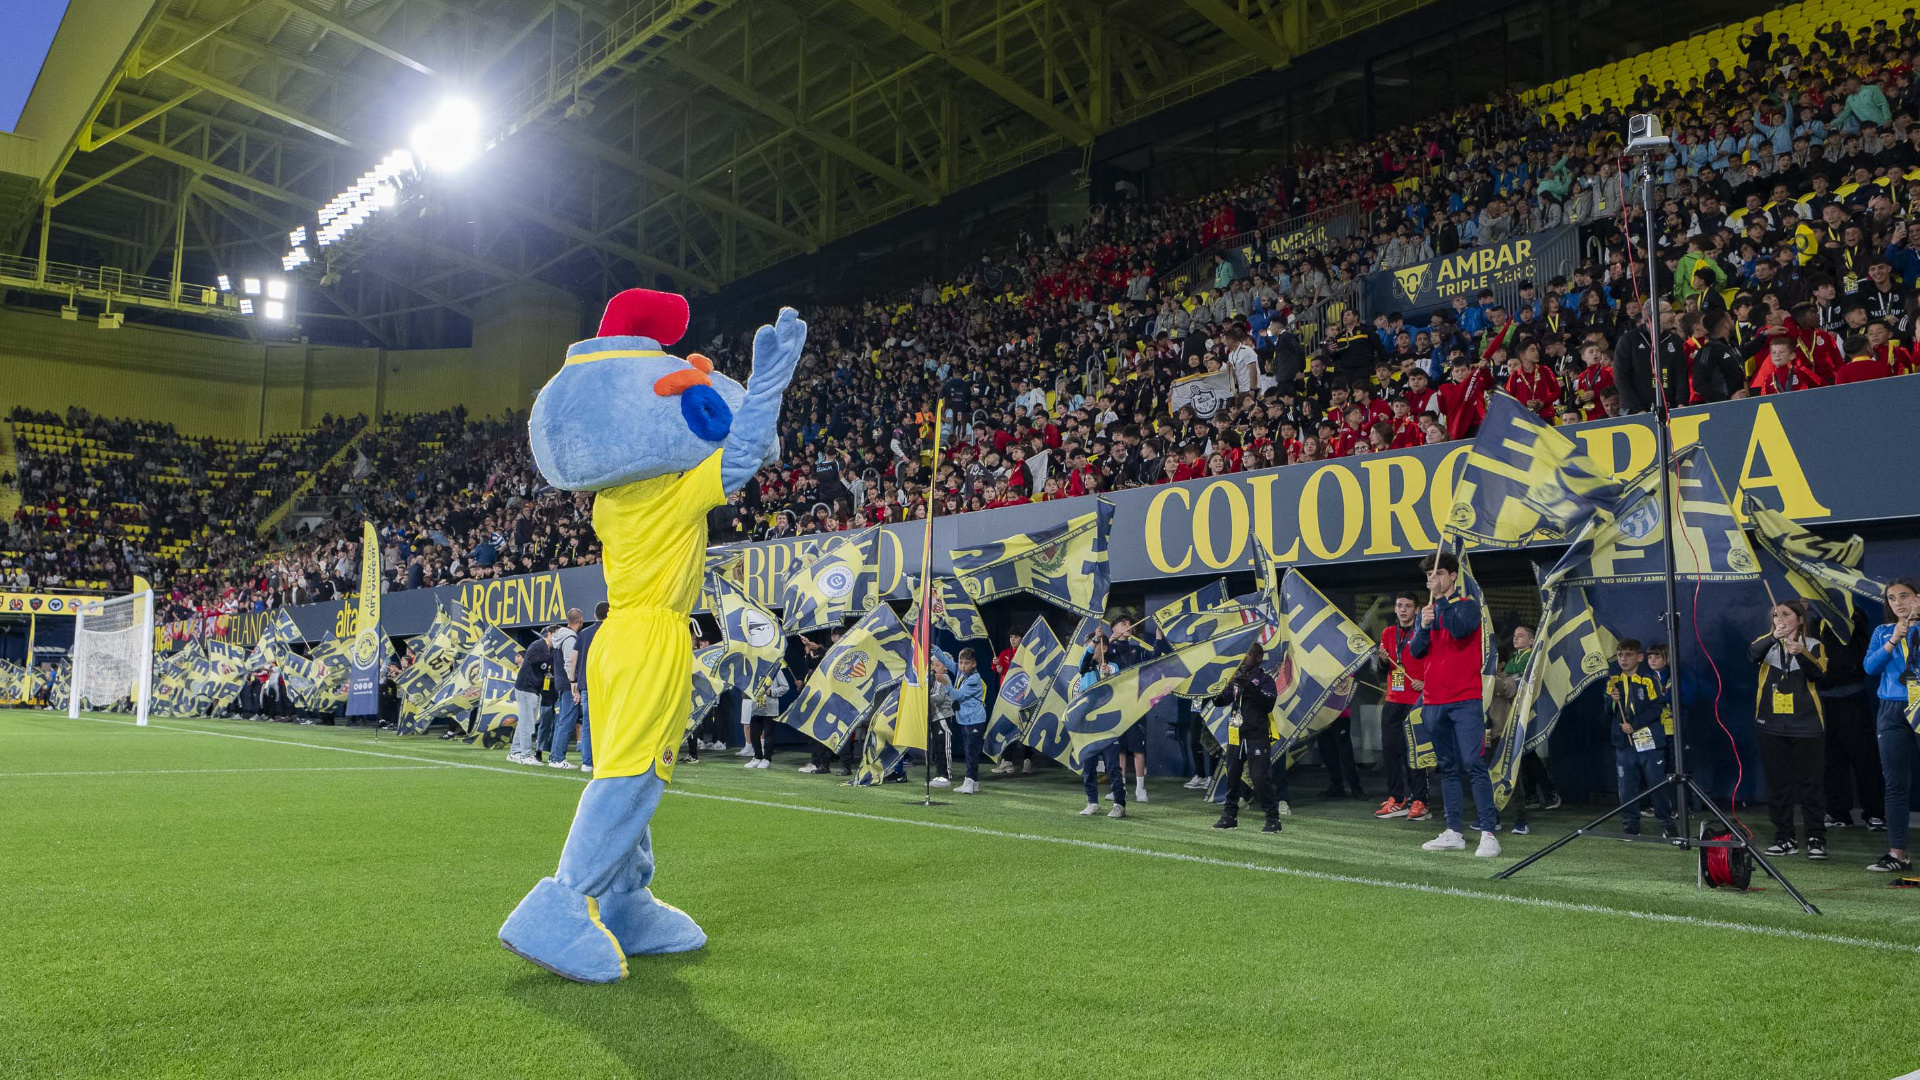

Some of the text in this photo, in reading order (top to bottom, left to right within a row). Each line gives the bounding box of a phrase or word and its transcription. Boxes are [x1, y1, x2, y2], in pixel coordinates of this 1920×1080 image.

[1437, 240, 1532, 283] AMBAR
[1437, 276, 1488, 298] TRIPLE
[459, 572, 566, 628] ARGENTA
